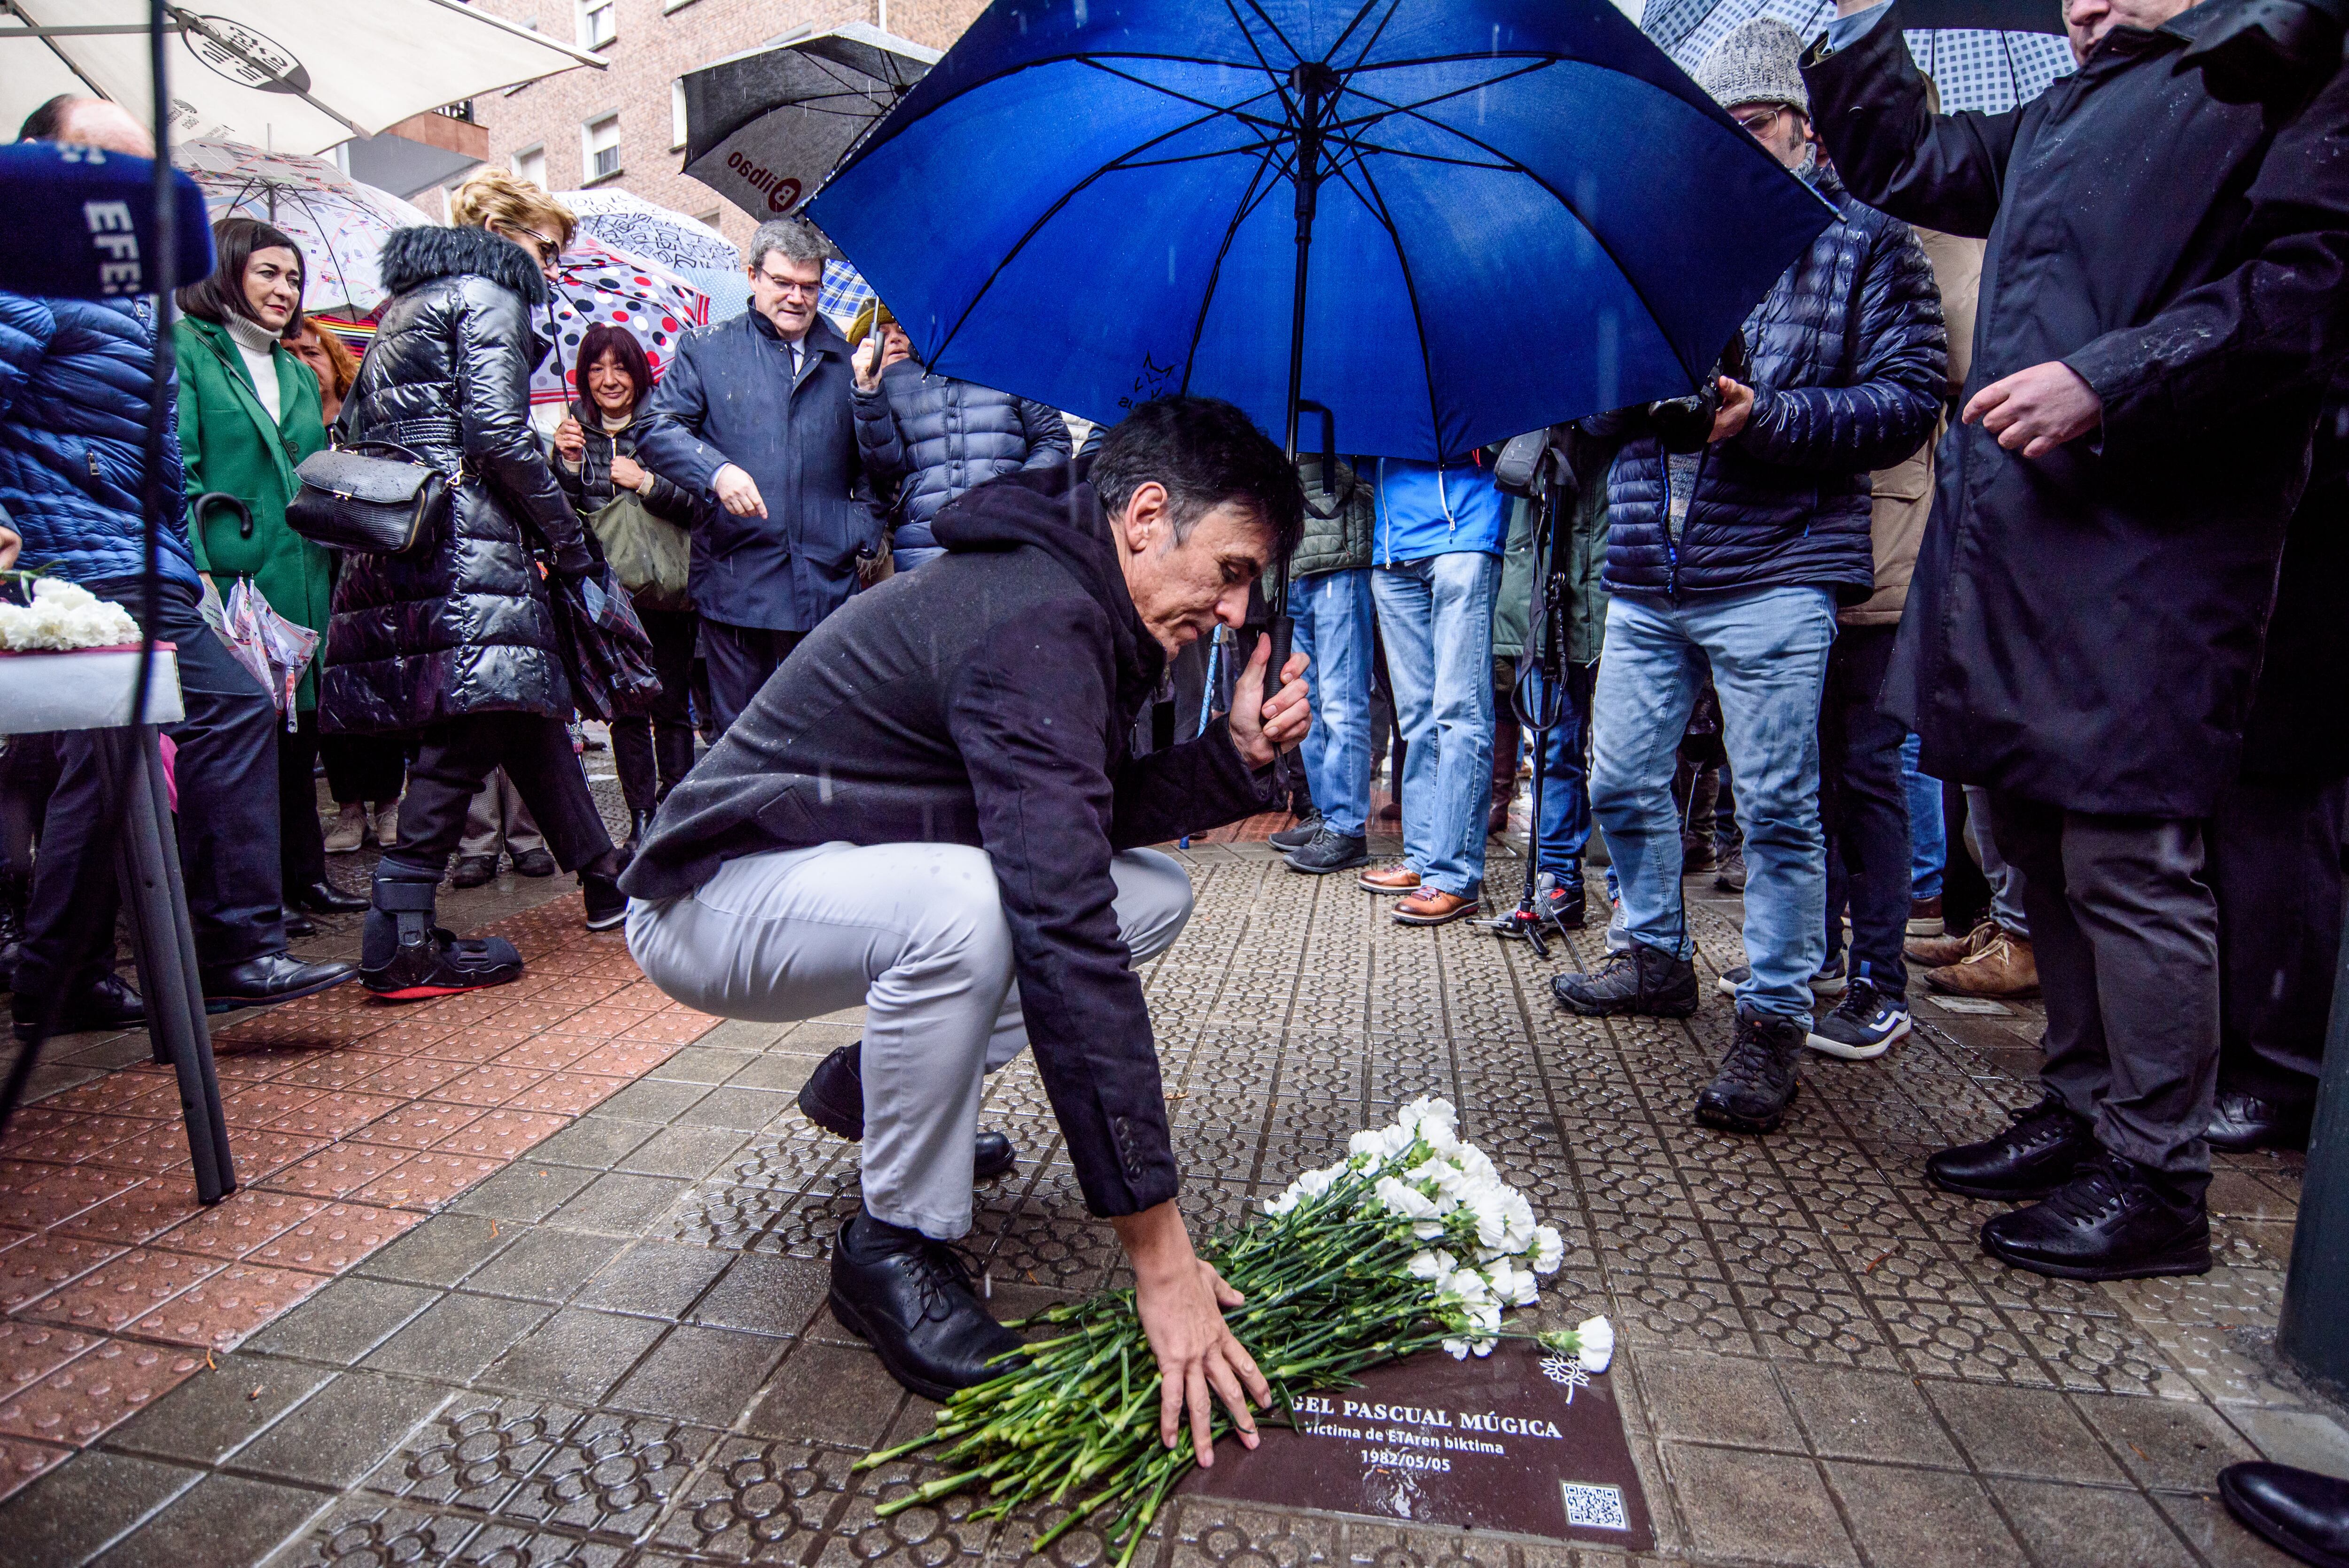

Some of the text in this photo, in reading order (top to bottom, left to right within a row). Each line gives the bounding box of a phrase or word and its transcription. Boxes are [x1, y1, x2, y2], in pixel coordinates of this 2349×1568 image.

[1291, 1396, 1563, 1438] GEL PASCUAL MÚGICA
[1365, 1426, 1384, 1442] de
[1388, 1429, 1440, 1448] ETAren
[1444, 1436, 1504, 1454] biktima
[1361, 1449, 1451, 1472] 1982/05/05
